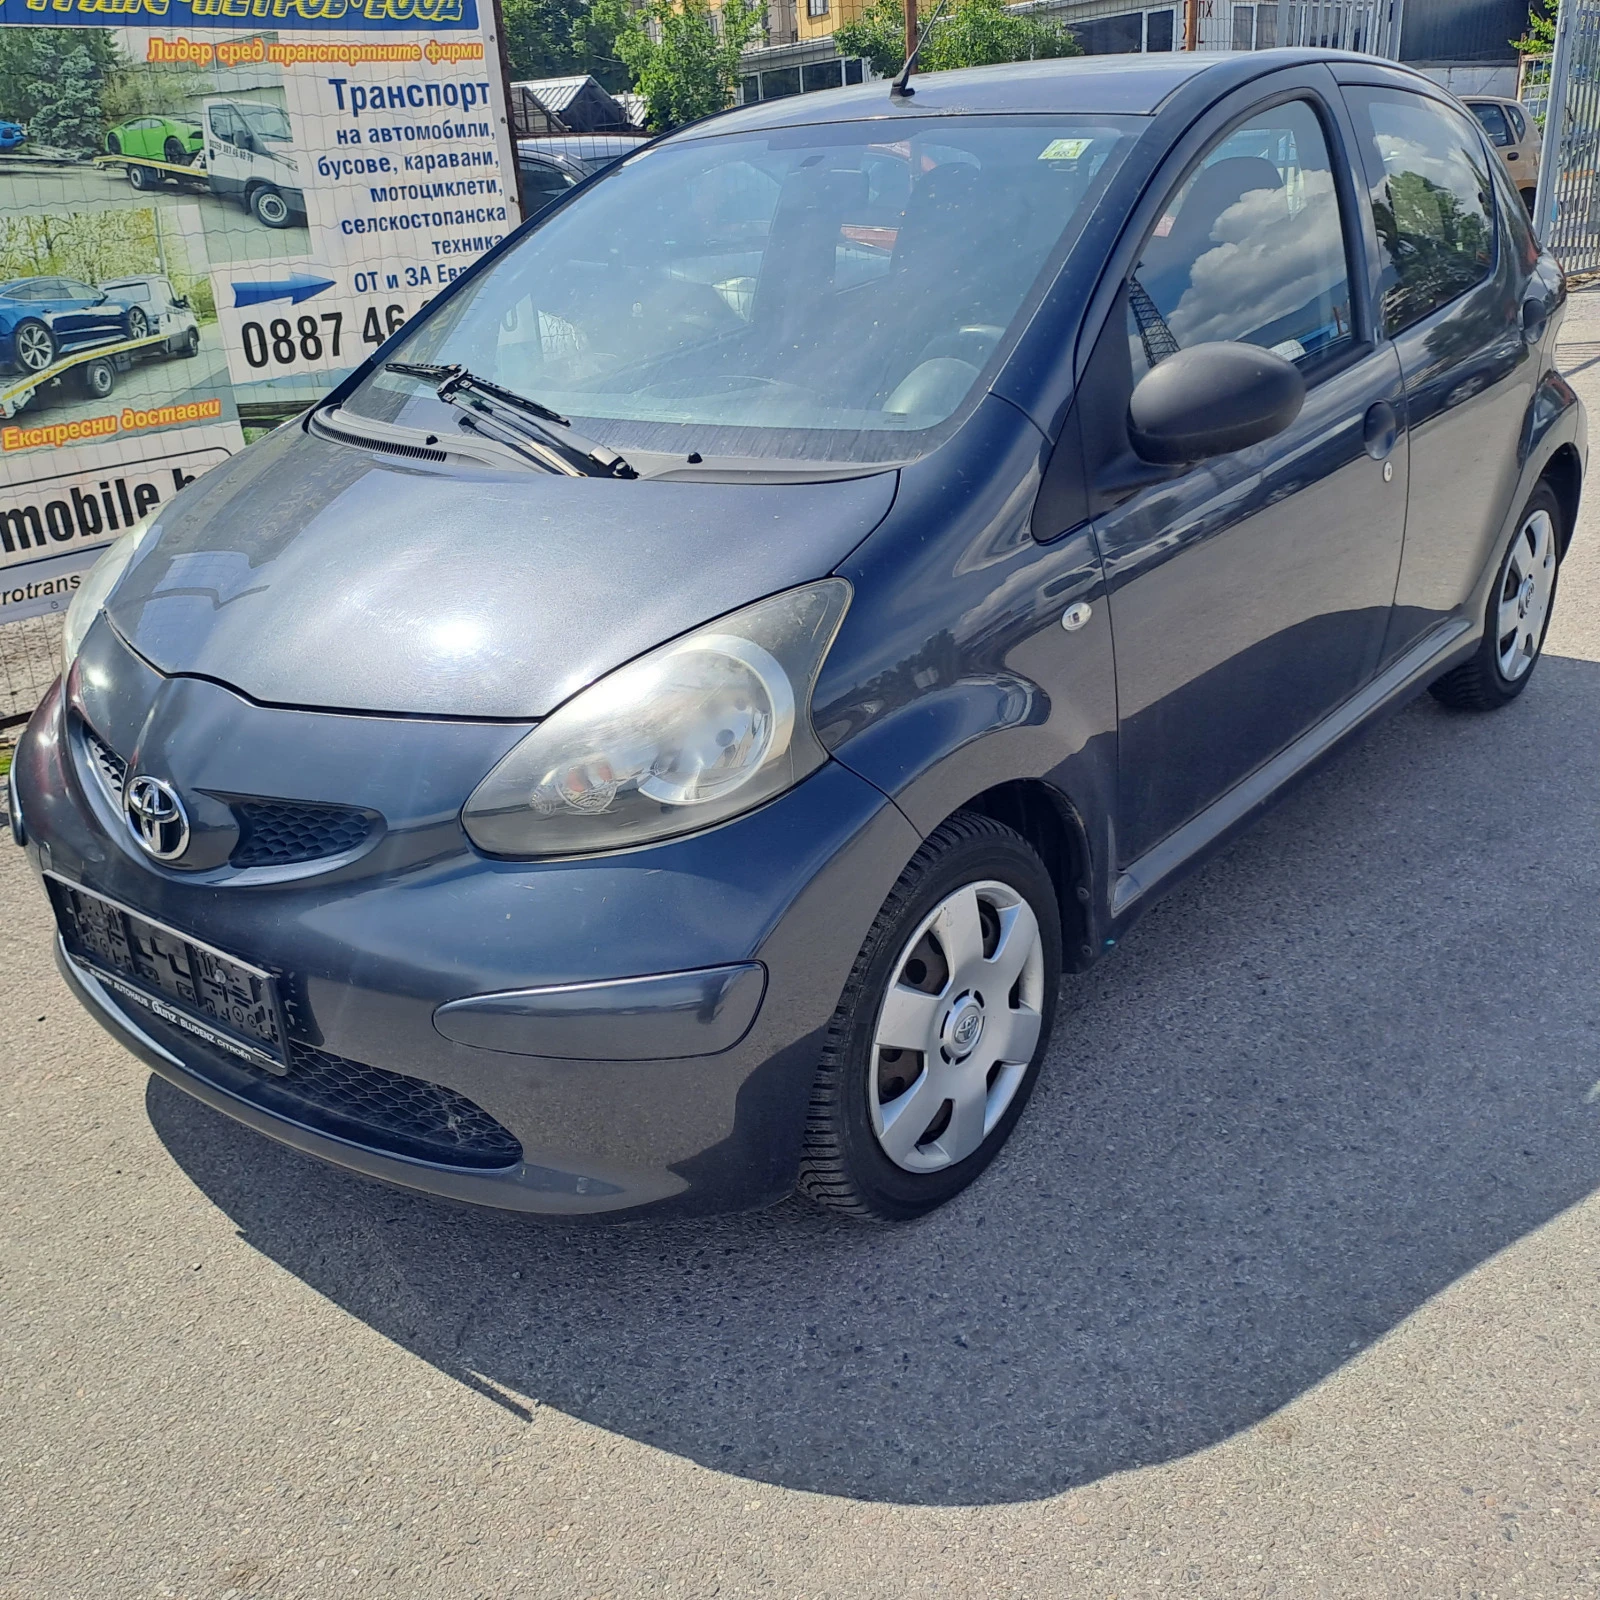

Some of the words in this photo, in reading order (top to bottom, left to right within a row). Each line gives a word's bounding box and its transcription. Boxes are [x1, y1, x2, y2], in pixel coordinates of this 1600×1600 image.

[147, 37, 213, 66] Лидер
[216, 38, 264, 67] сред
[267, 42, 422, 67] транспортните
[425, 39, 483, 64] фирми
[328, 78, 490, 117] Транспорт
[336, 129, 361, 144] на
[369, 119, 496, 144] автомобили,
[317, 155, 398, 180] бусове,
[404, 150, 499, 174] каравани,
[370, 179, 503, 203] мотоциклети,
[341, 206, 506, 235] селскостопанска
[354, 271, 378, 292] ОТ
[386, 275, 399, 289] и
[405, 266, 432, 287] ЗА
[242, 312, 343, 368] 0887
[363, 304, 405, 347] 46
[2, 416, 117, 450] Експресни
[121, 398, 222, 431] доставки
[0, 575, 81, 605] rotrans
[180, 1018, 216, 1045] BLUDENZ
